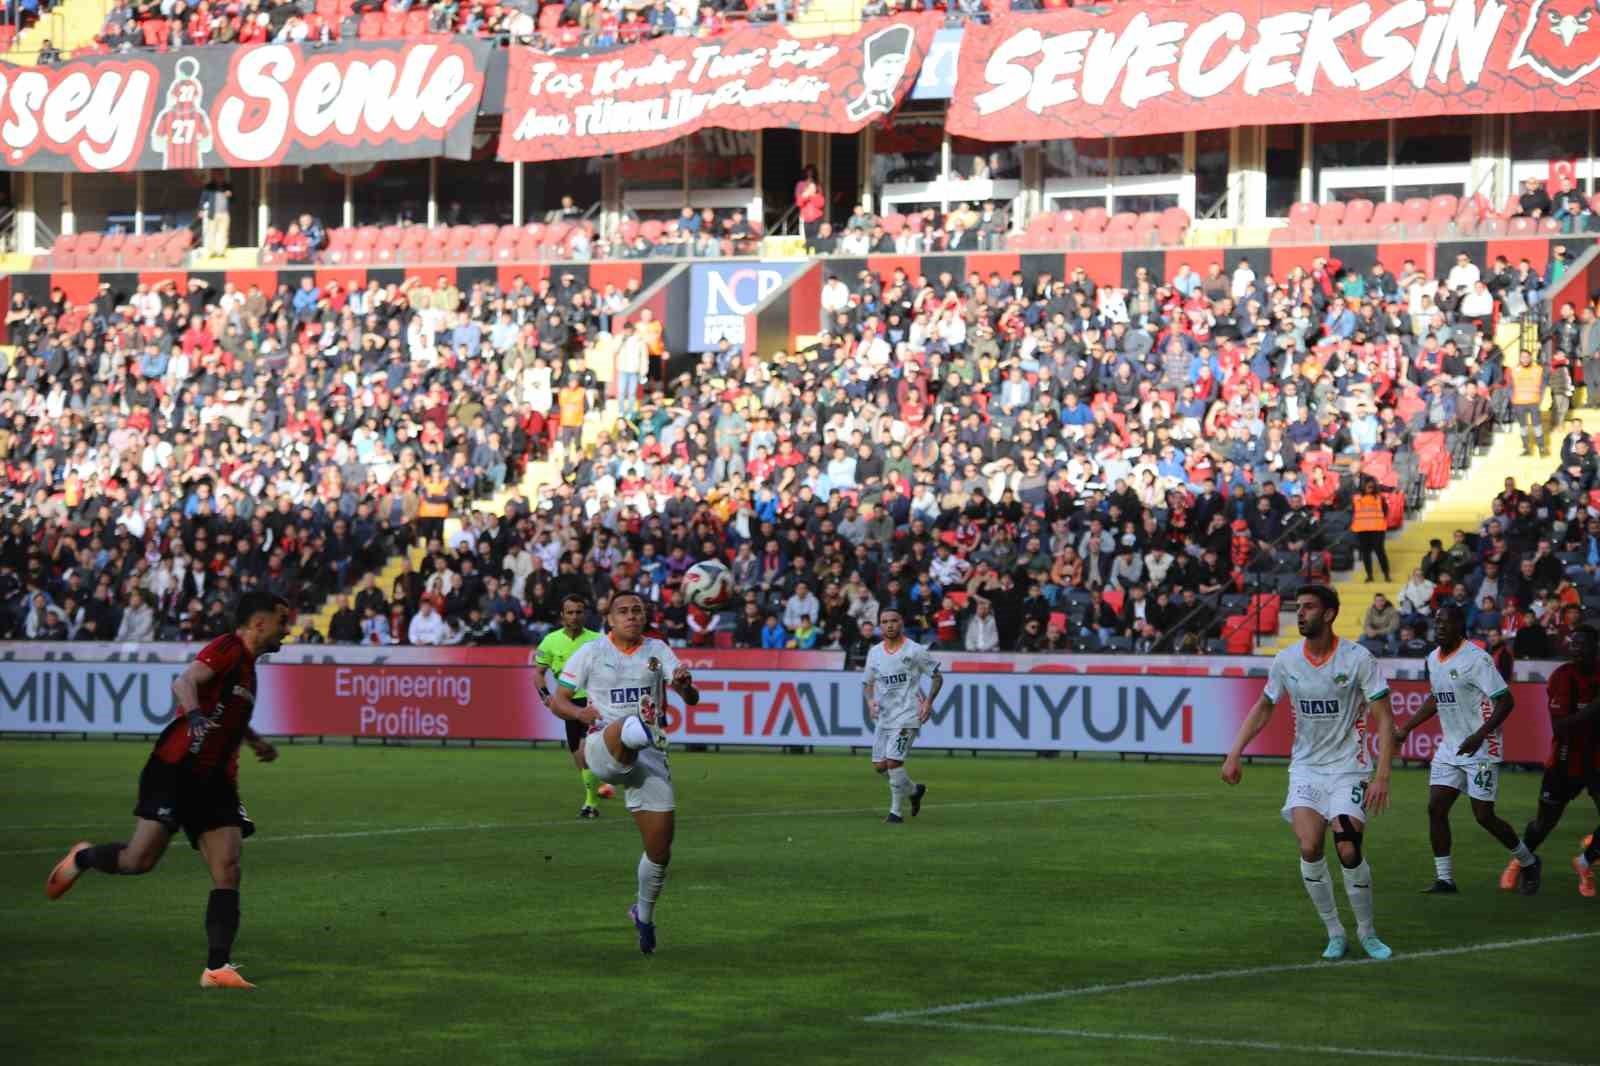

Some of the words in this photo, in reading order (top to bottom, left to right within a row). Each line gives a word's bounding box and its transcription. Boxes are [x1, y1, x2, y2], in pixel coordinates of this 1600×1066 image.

[529, 61, 585, 99] Taş
[172, 119, 196, 144] 27
[0, 671, 180, 725] MINYU
[335, 667, 471, 706] Engineering
[360, 705, 449, 736] Profiles
[1474, 770, 1494, 788] 42
